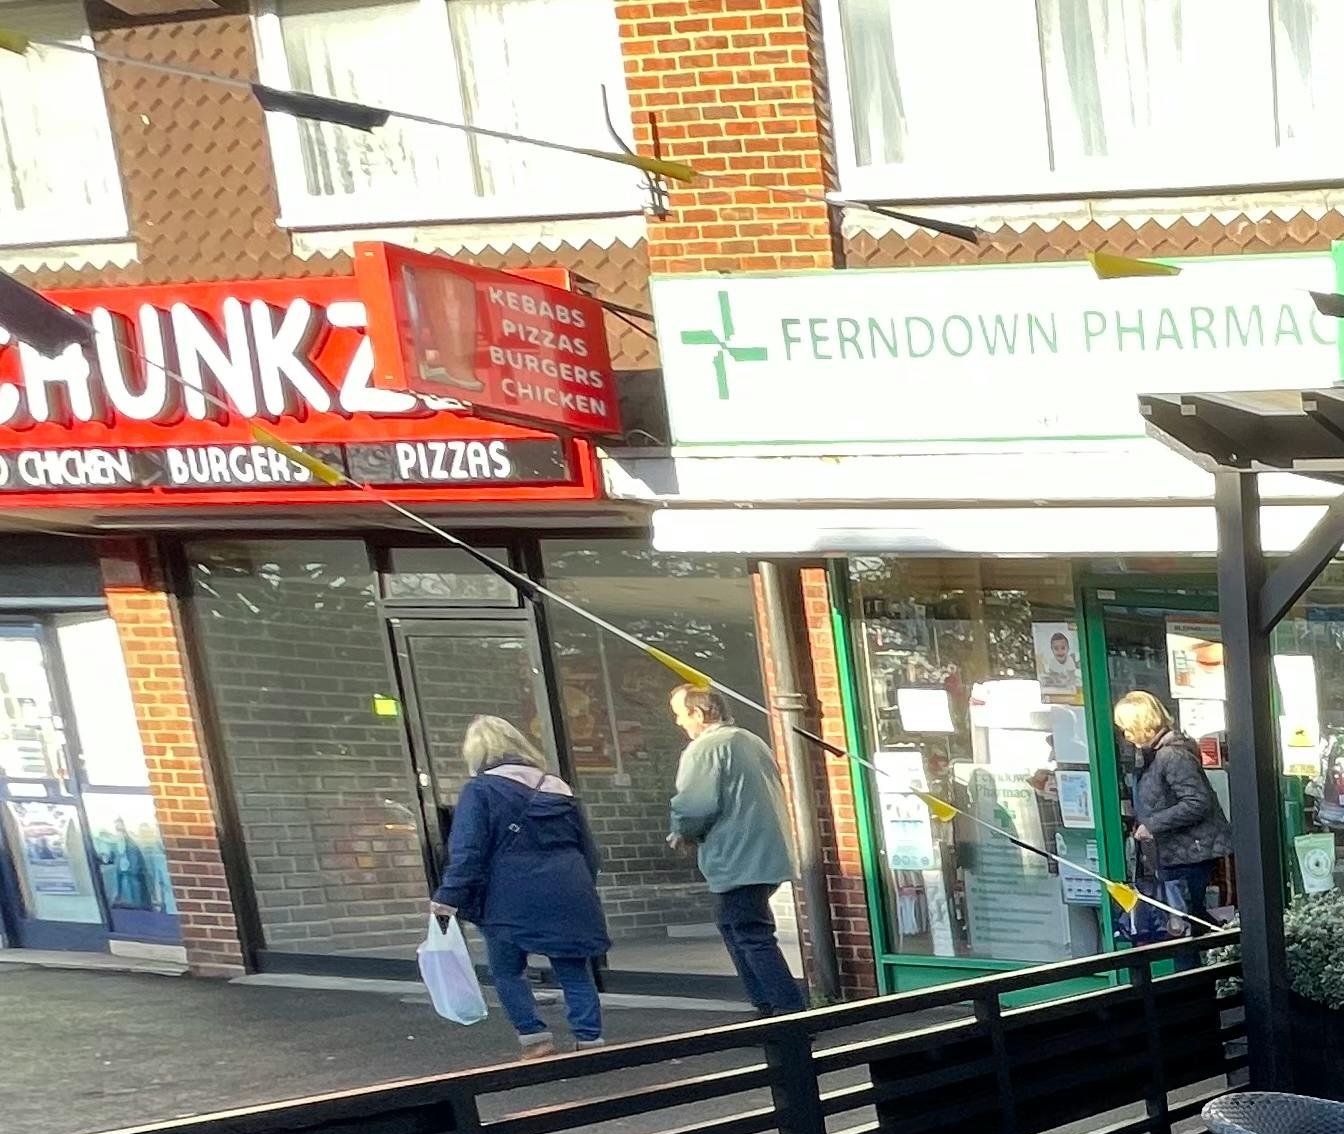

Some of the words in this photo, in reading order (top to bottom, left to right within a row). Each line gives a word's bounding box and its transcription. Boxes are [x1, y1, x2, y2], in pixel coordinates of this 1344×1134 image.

[488, 286, 585, 328] KEBABS
[502, 319, 588, 357] PIZZAS
[782, 310, 1058, 361] FERNDOWN
[1085, 302, 1338, 352] PHARMAC
[489, 345, 604, 389] BURGERS
[501, 377, 606, 416] CHICKEN
[18, 449, 134, 486] CHICKEN
[395, 440, 511, 480] PIZZAS
